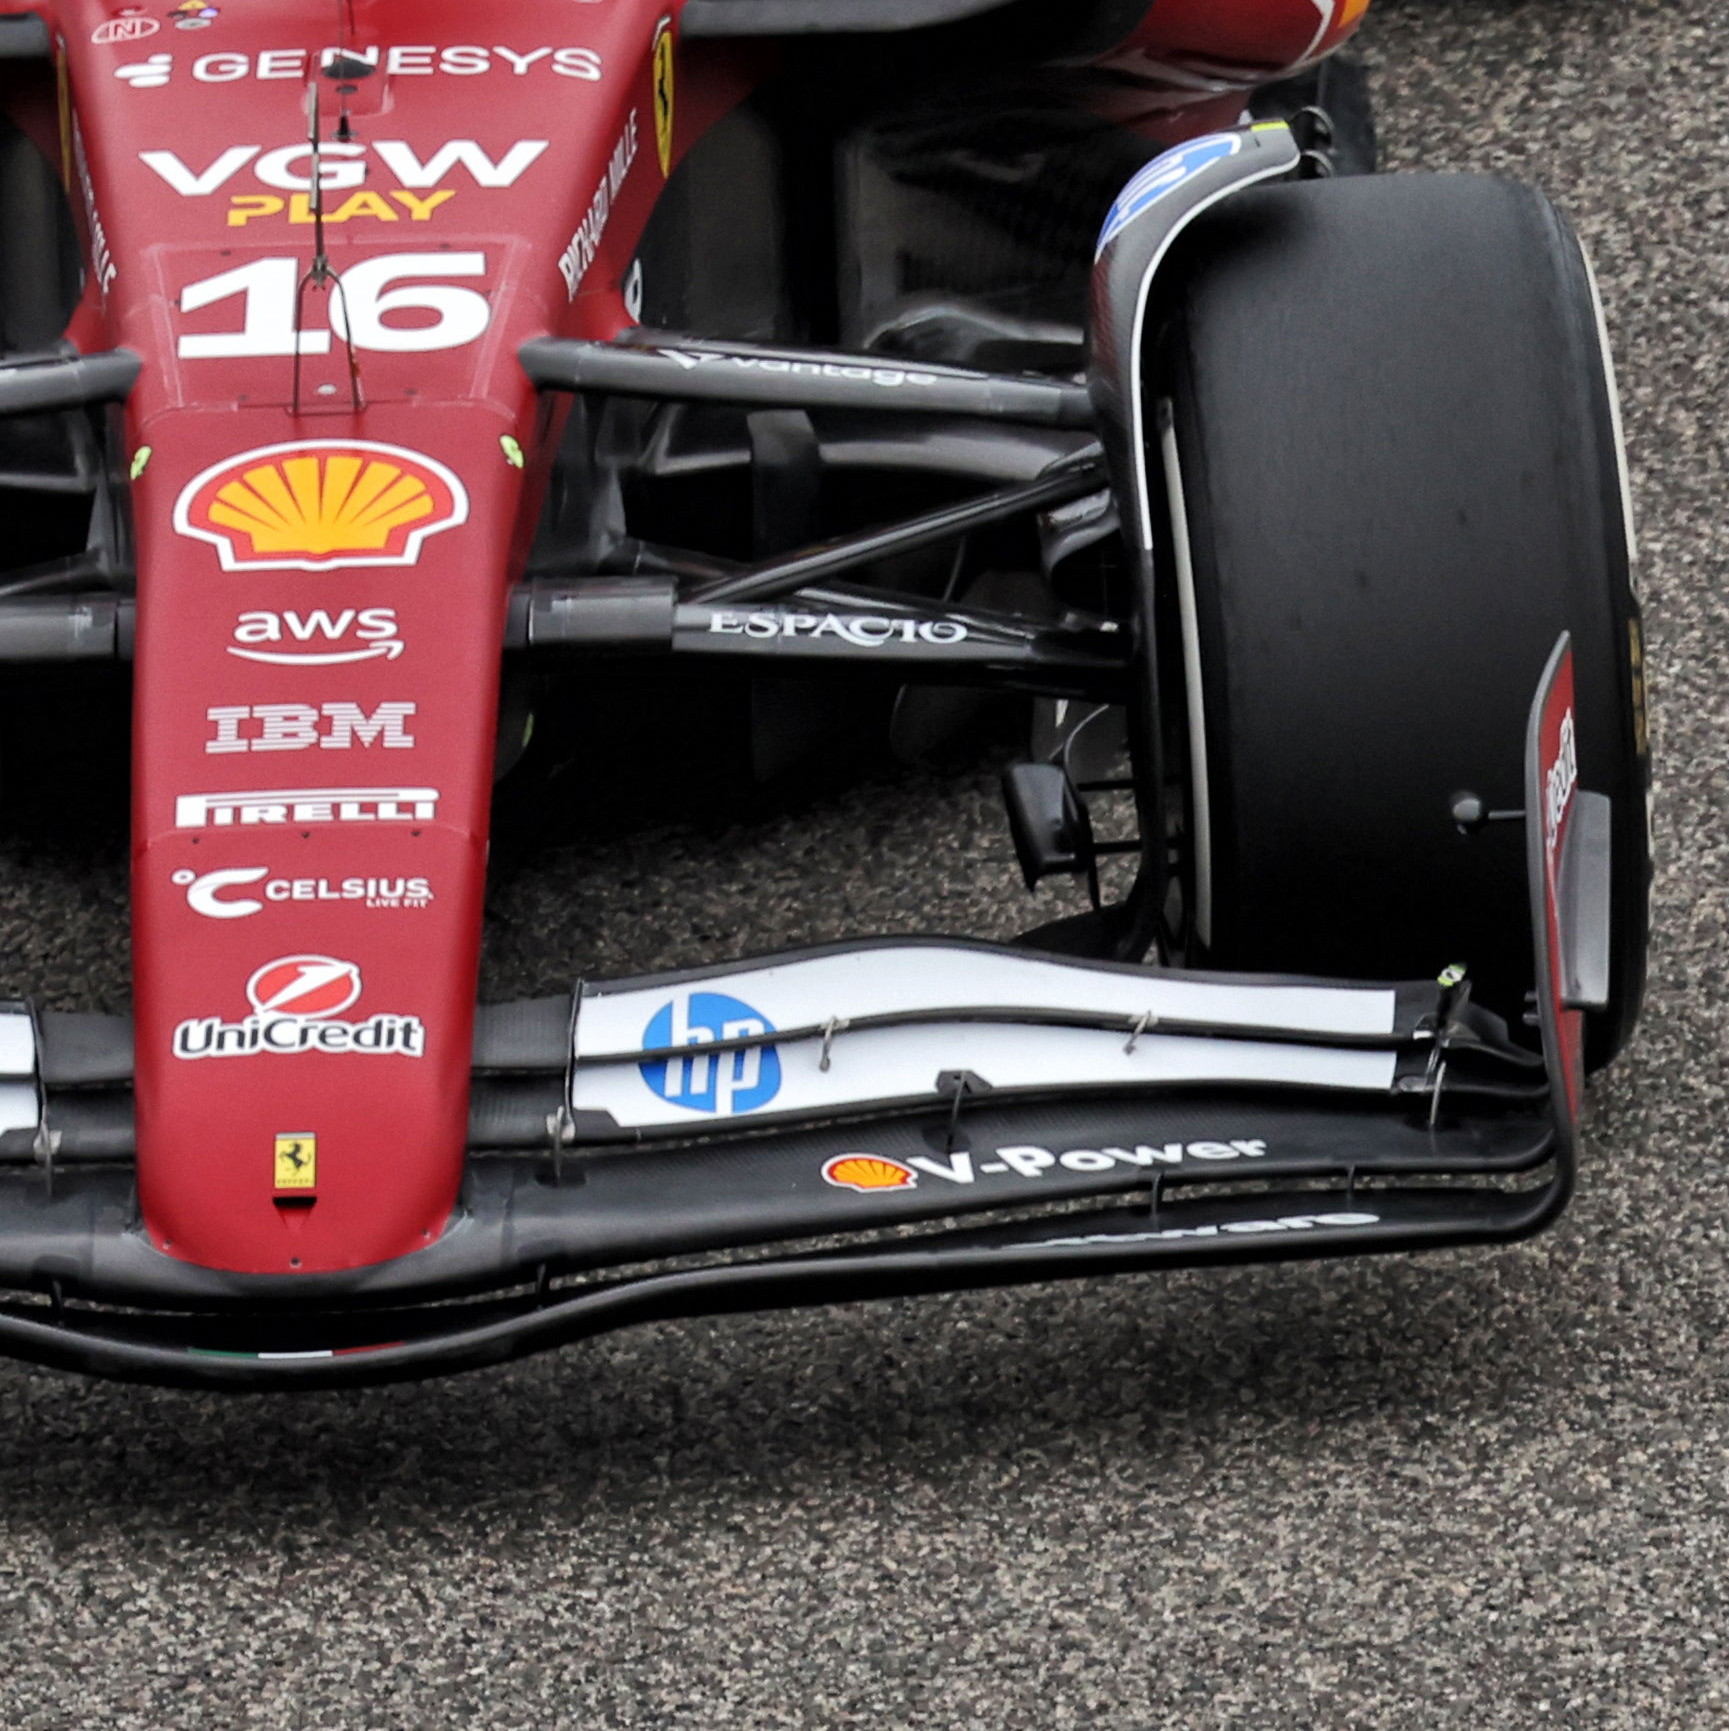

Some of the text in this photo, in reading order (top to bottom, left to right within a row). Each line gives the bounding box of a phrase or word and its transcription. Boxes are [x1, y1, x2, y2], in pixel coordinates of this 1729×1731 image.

[191, 45, 604, 83] GENESYS
[137, 139, 550, 197] VGW
[226, 189, 458, 227] PLAY
[176, 250, 492, 359] 16
[730, 356, 937, 387] vantage
[233, 607, 399, 643] aws
[708, 610, 969, 647] ESPACIO
[205, 701, 417, 754] IBM
[174, 786, 441, 828] PIRELLI
[264, 877, 429, 901] CELSIUS
[365, 897, 428, 909] LIVE FIT
[178, 1016, 420, 1054] UniCredit
[664, 992, 766, 1114] hp
[907, 1136, 1269, 1184] V-Power
